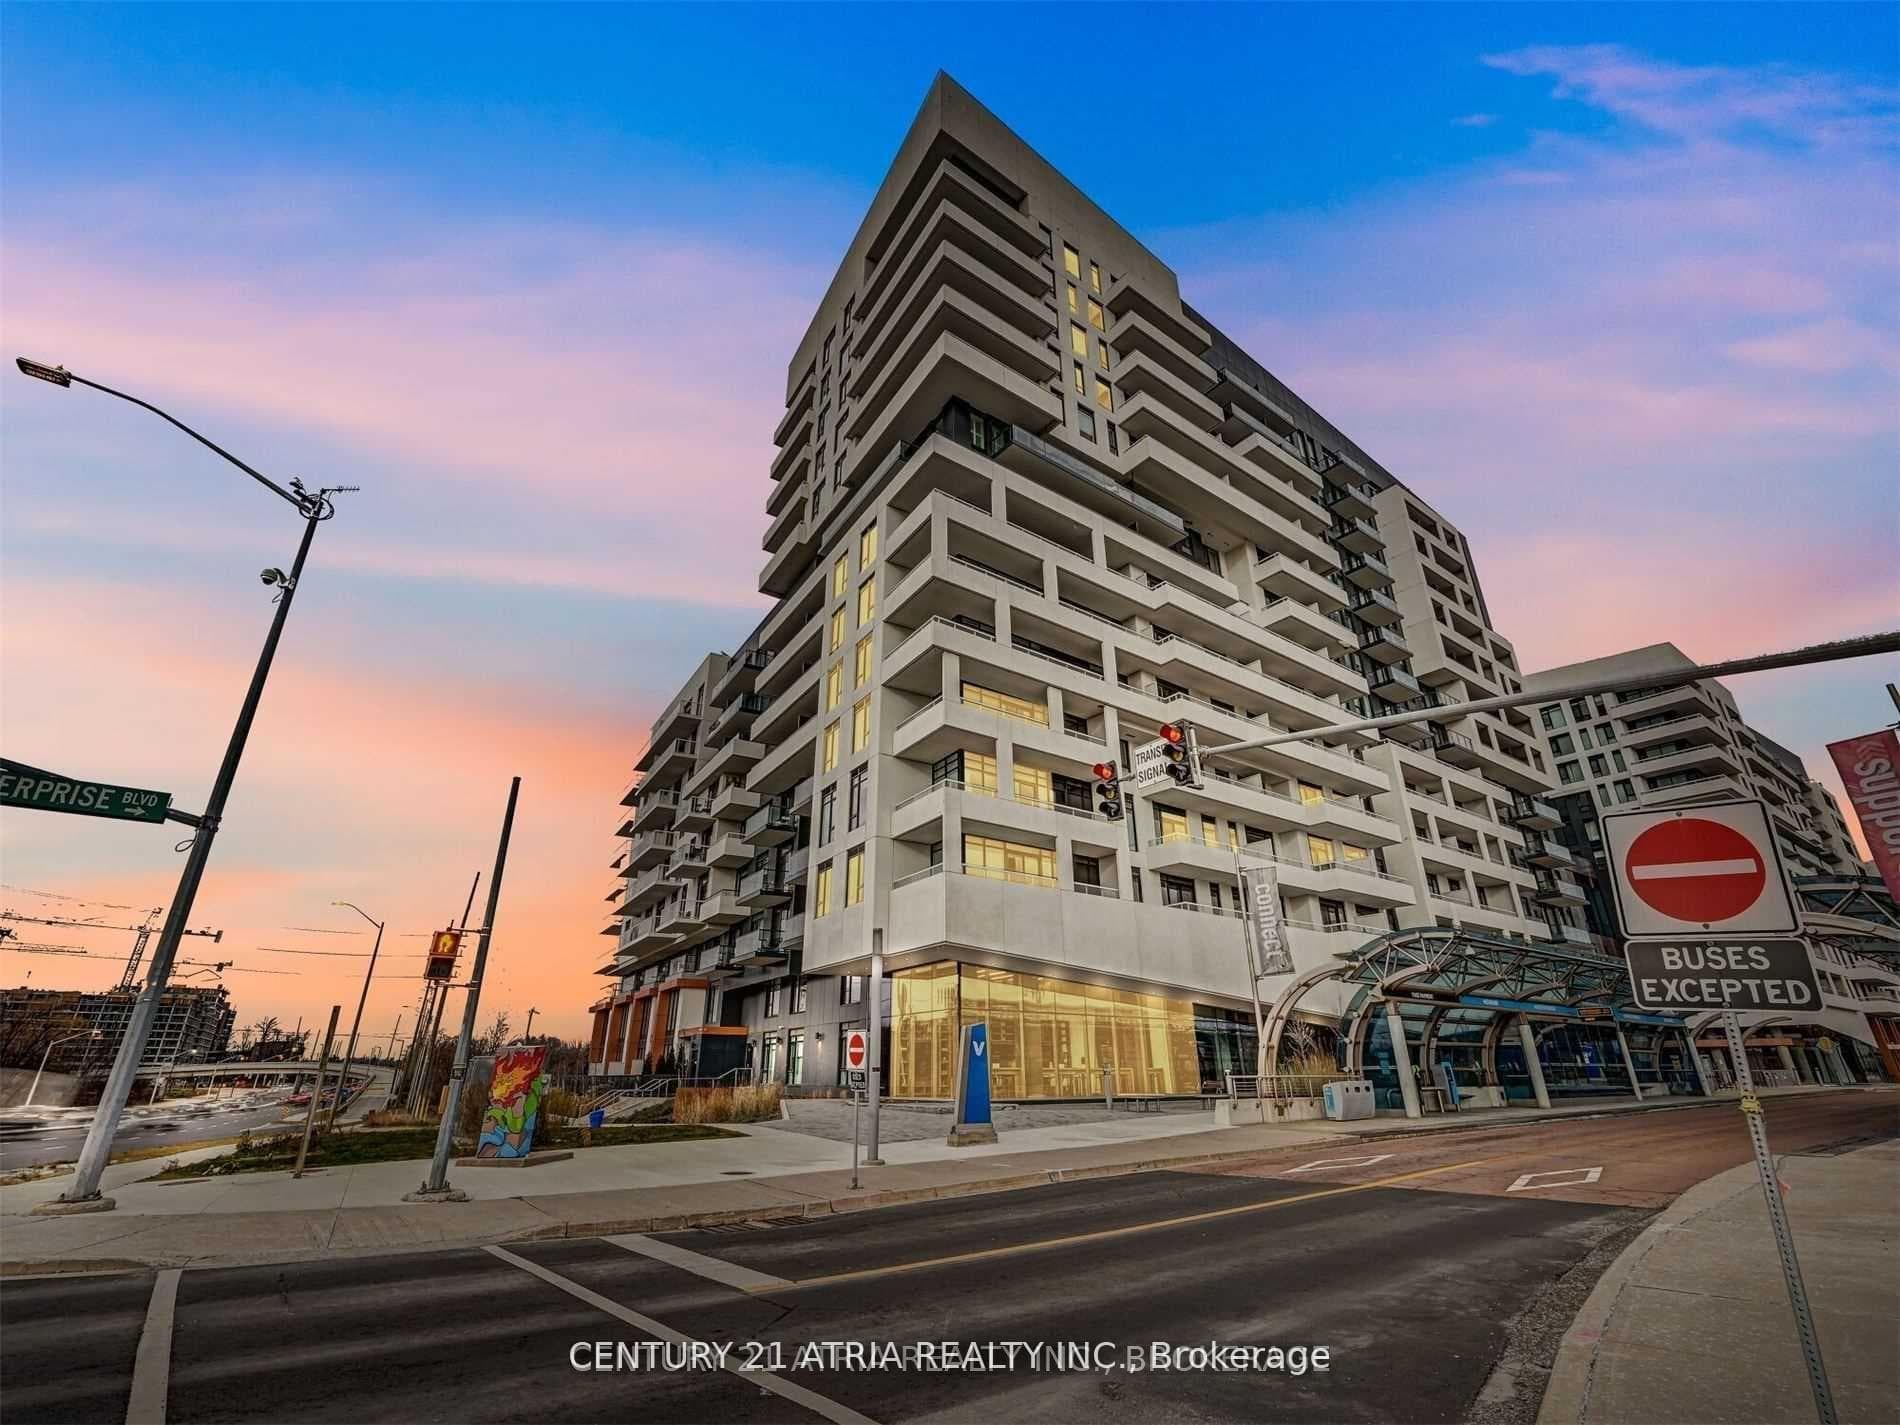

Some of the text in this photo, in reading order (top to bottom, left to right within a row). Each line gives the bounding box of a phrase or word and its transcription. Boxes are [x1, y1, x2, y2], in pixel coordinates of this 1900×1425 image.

[122, 791, 158, 807] BLVD
[1255, 883, 1286, 960] connect
[1661, 946, 1770, 970] BUSES
[1641, 978, 1811, 1005] EXCEPTED
